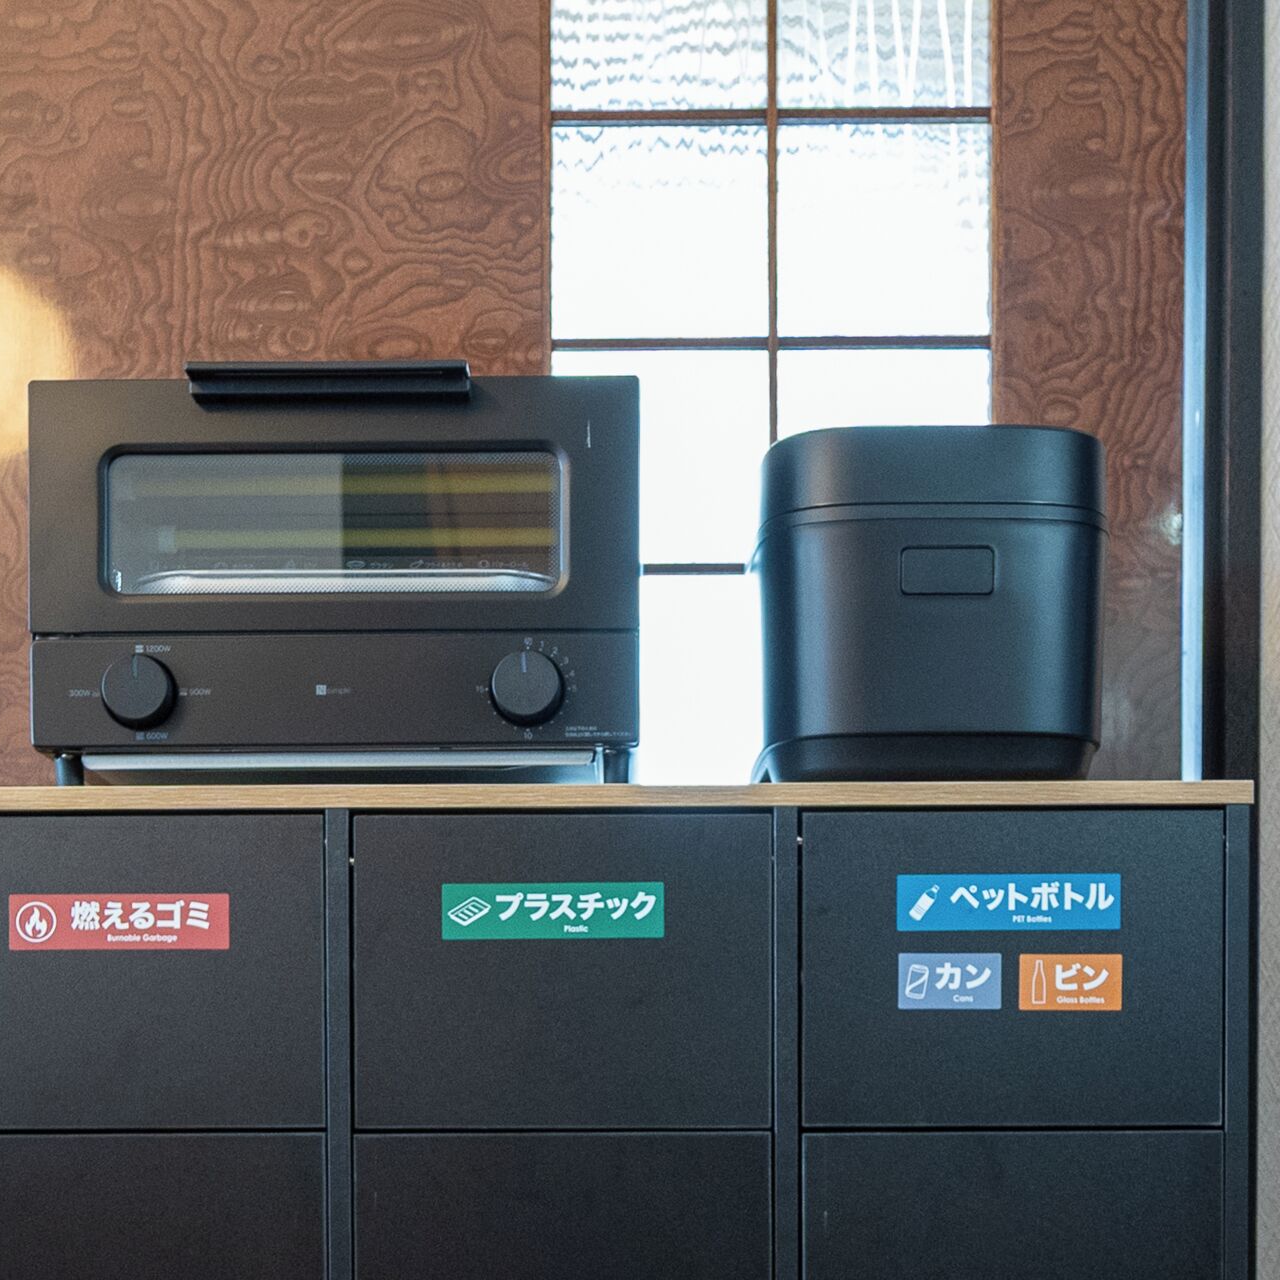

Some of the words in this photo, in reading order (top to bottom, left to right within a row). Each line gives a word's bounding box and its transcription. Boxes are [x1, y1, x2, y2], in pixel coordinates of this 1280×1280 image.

[523, 731, 533, 740] 10
[949, 881, 1115, 911] ペットボトル
[495, 891, 657, 921] プラスチック
[70, 900, 210, 931] 燃えるゴミ
[1012, 914, 1025, 924] PET
[1026, 914, 1052, 924] Bottles
[563, 924, 589, 933] Plastic
[106, 933, 141, 943] Burnable
[142, 933, 178, 943] Garbage
[935, 962, 992, 990] カン
[1055, 963, 1109, 991] ビン
[953, 994, 974, 1004] Cans
[1056, 995, 1078, 1005] Glass
